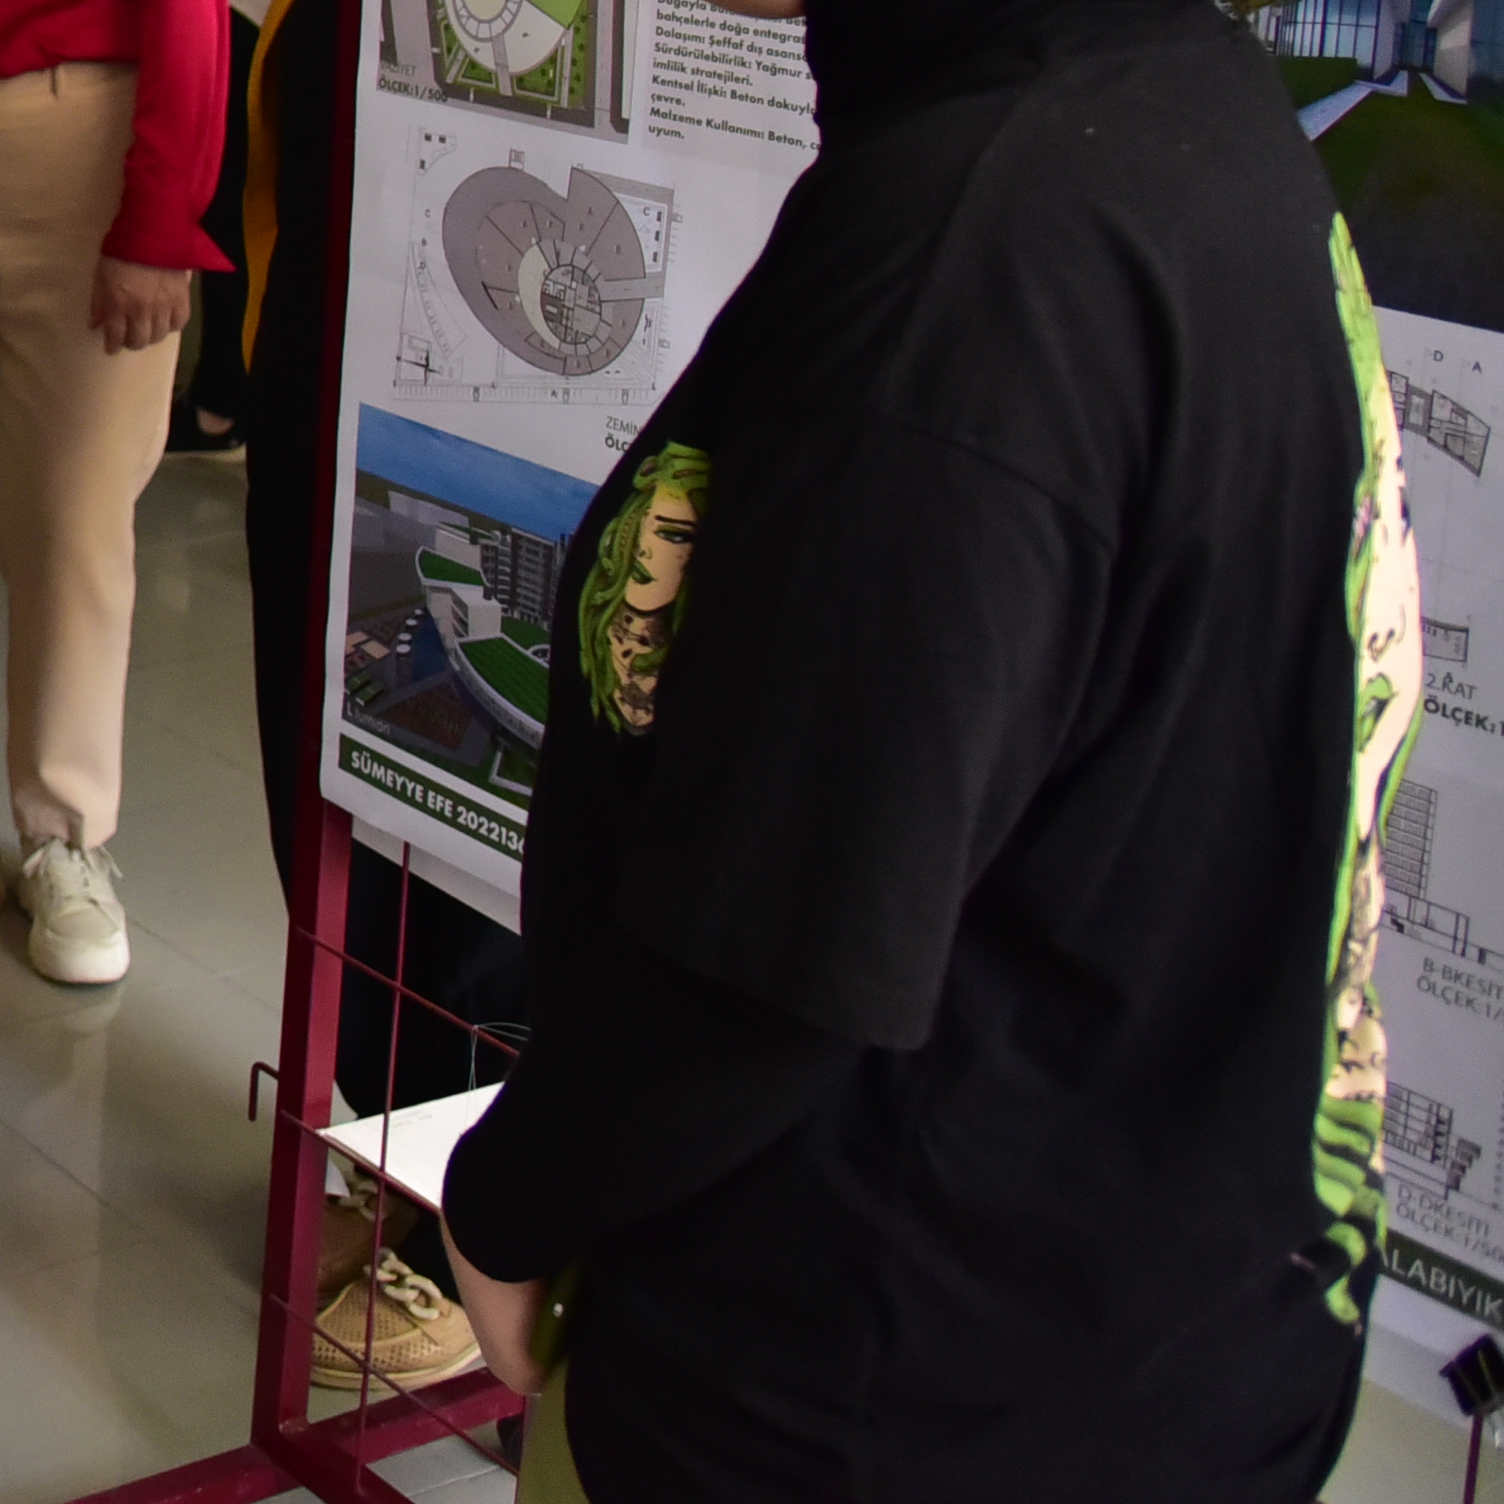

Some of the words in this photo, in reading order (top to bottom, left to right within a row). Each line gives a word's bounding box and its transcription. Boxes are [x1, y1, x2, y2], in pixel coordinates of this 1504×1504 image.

[656, 8, 716, 30] bahçelerle
[718, 20, 750, 37] doğa
[655, 26, 706, 44] Dolaşım:
[708, 35, 744, 51] Şeffaf
[746, 40, 763, 56] dış
[653, 57, 687, 74] imlilik
[690, 66, 754, 87] stratejileri.
[654, 42, 752, 70] Sürdürülebilirlik:
[755, 60, 803, 78] Yağmur
[650, 91, 686, 108] çevre.
[652, 74, 694, 92] Kentsel
[696, 79, 727, 99] İlişki:
[730, 88, 765, 105] Beton
[648, 125, 685, 141] uyum.
[649, 107, 703, 127] Malzeme
[705, 118, 765, 140] Kullanımı:
[767, 130, 807, 151] Beton,
[350, 749, 425, 804] SÜMEYYE
[426, 789, 454, 818] EFE
